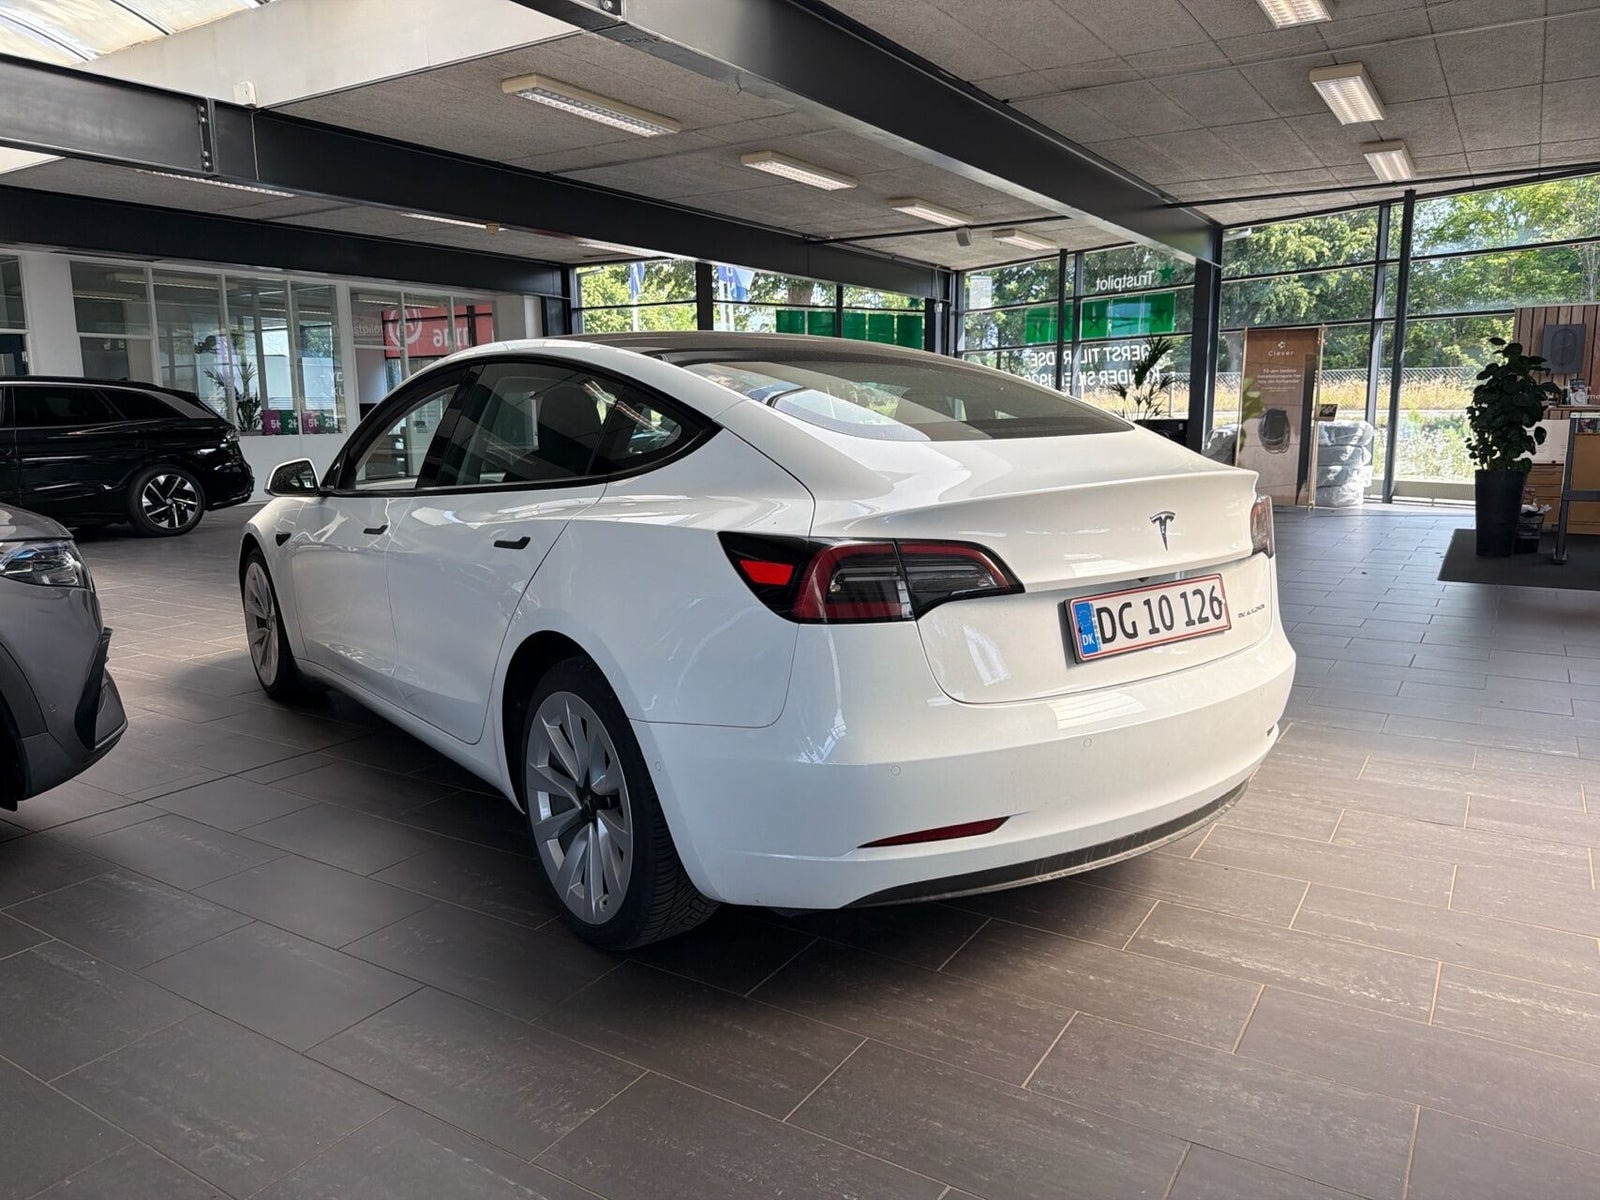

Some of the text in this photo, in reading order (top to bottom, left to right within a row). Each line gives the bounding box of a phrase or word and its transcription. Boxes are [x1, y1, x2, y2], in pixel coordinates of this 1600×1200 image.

[1095, 585, 1223, 644] DG 10 126
[1082, 633, 1095, 646] DK
